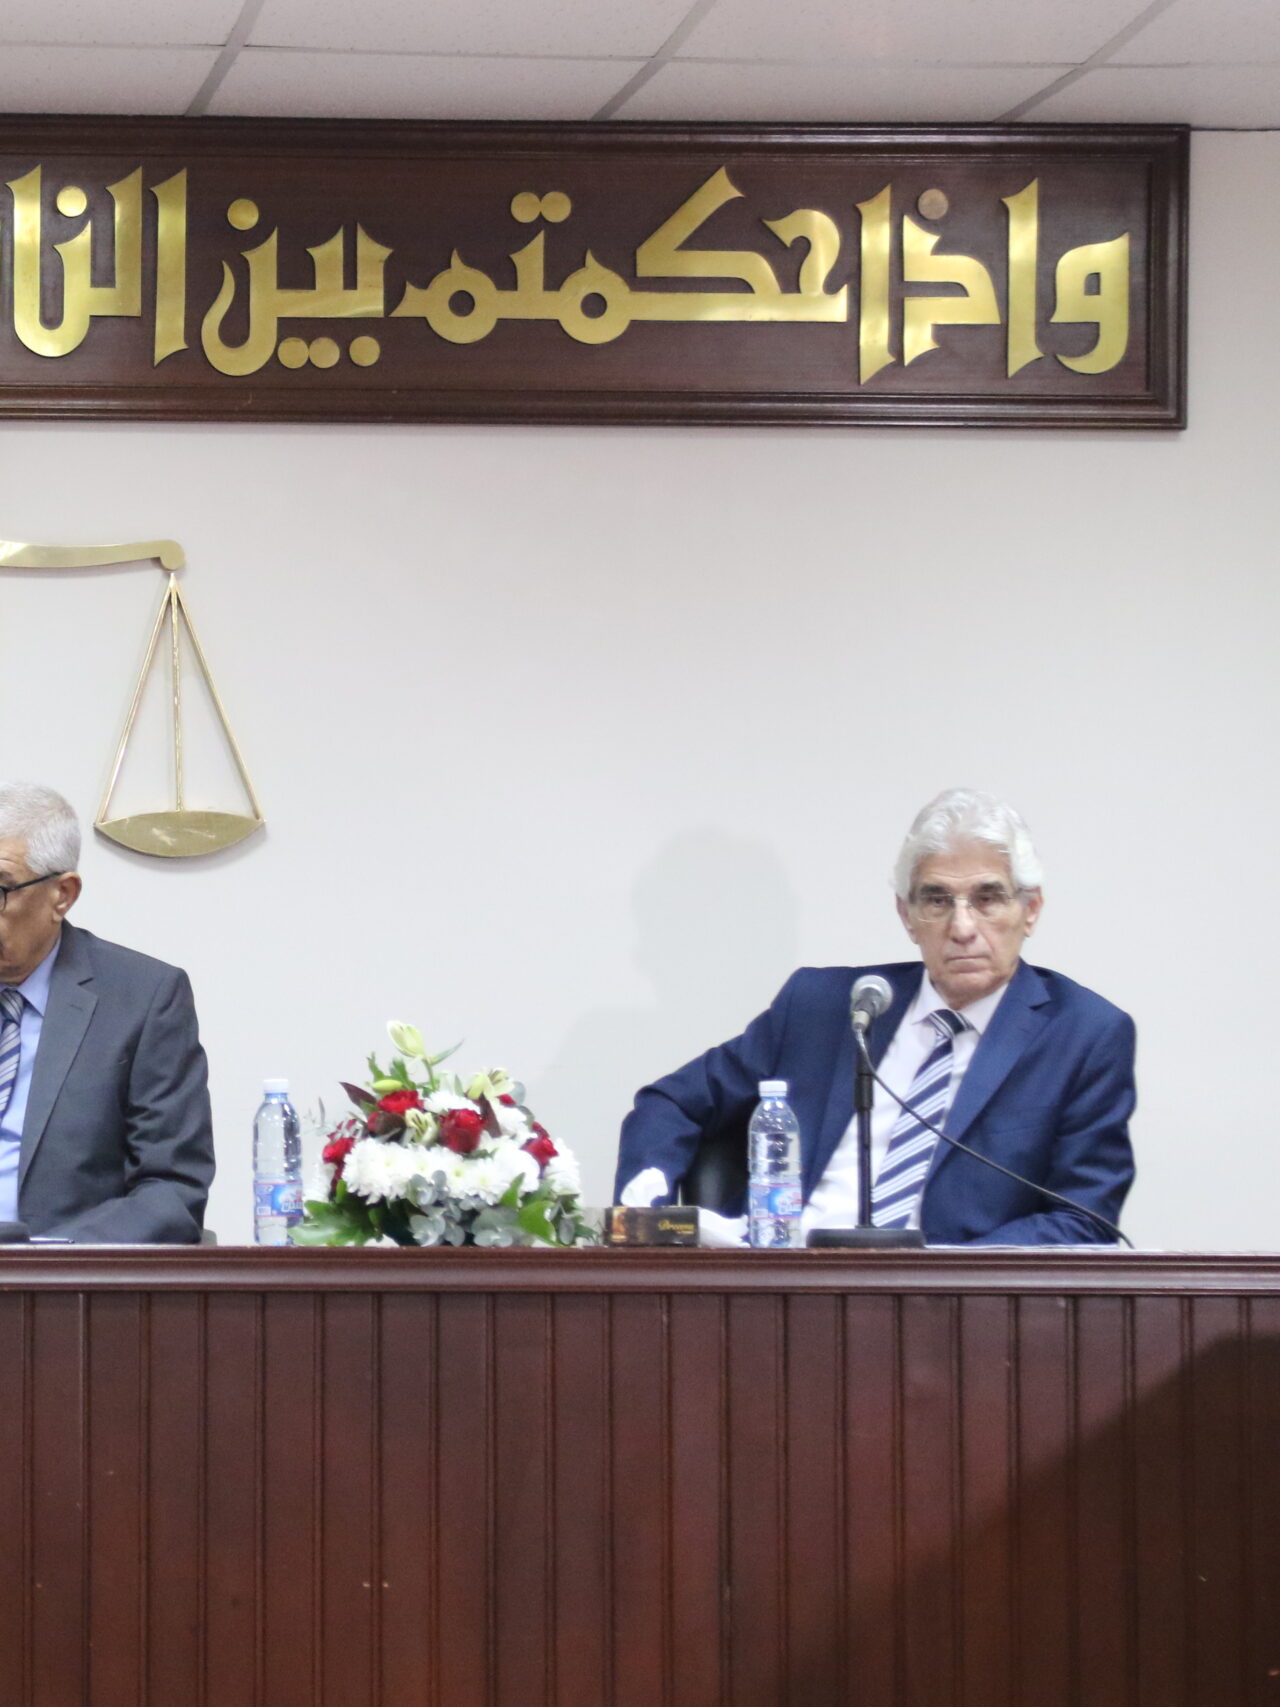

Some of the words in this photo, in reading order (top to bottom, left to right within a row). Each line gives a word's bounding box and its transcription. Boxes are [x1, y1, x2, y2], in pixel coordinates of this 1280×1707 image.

[200, 199, 395, 377] بين
[389, 165, 850, 345] حكمتم
[858, 176, 1132, 386] واذا
